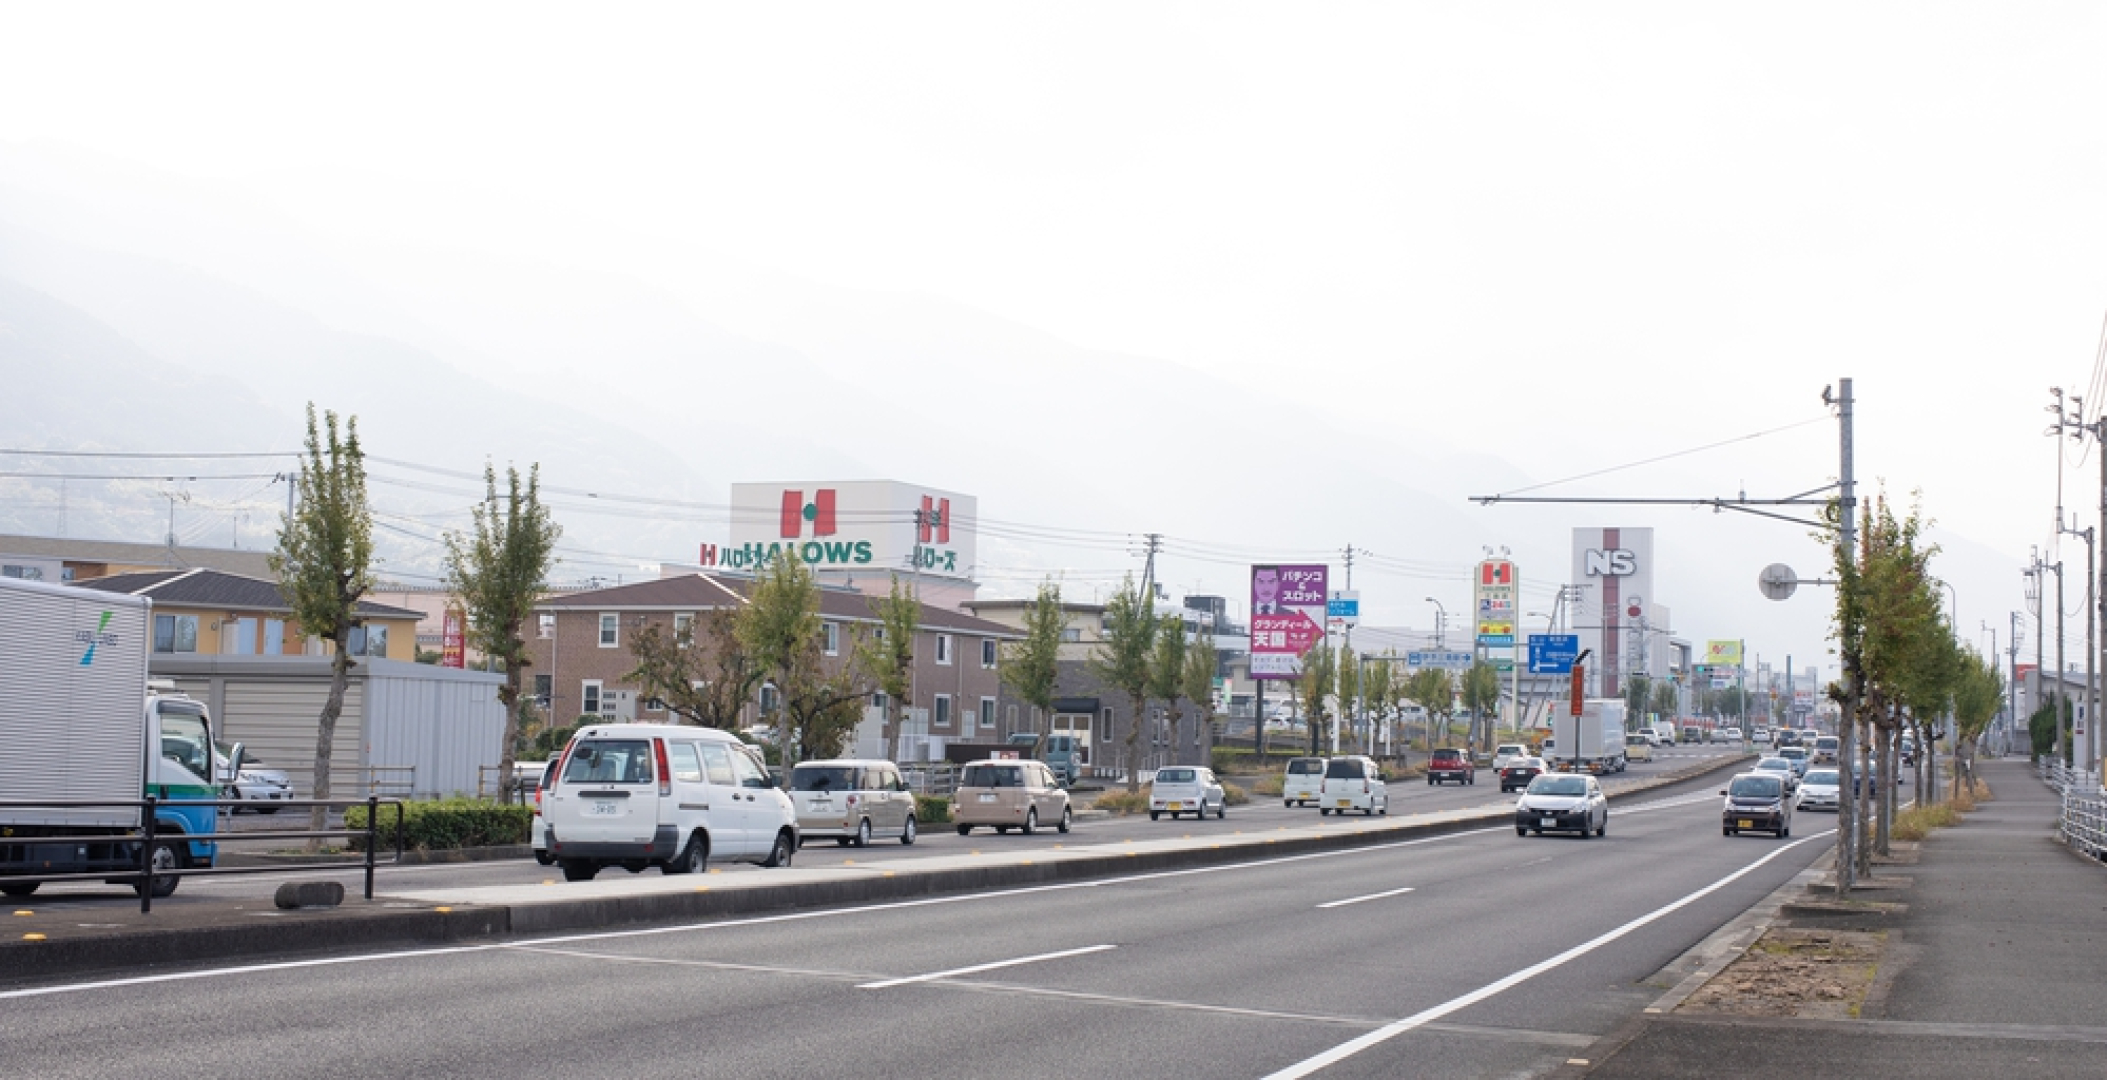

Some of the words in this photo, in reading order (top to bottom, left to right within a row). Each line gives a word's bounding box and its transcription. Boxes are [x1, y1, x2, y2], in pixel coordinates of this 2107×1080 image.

[1586, 548, 1637, 577] NS
[1282, 571, 1323, 582] パチンコ
[1282, 590, 1323, 602] スロット
